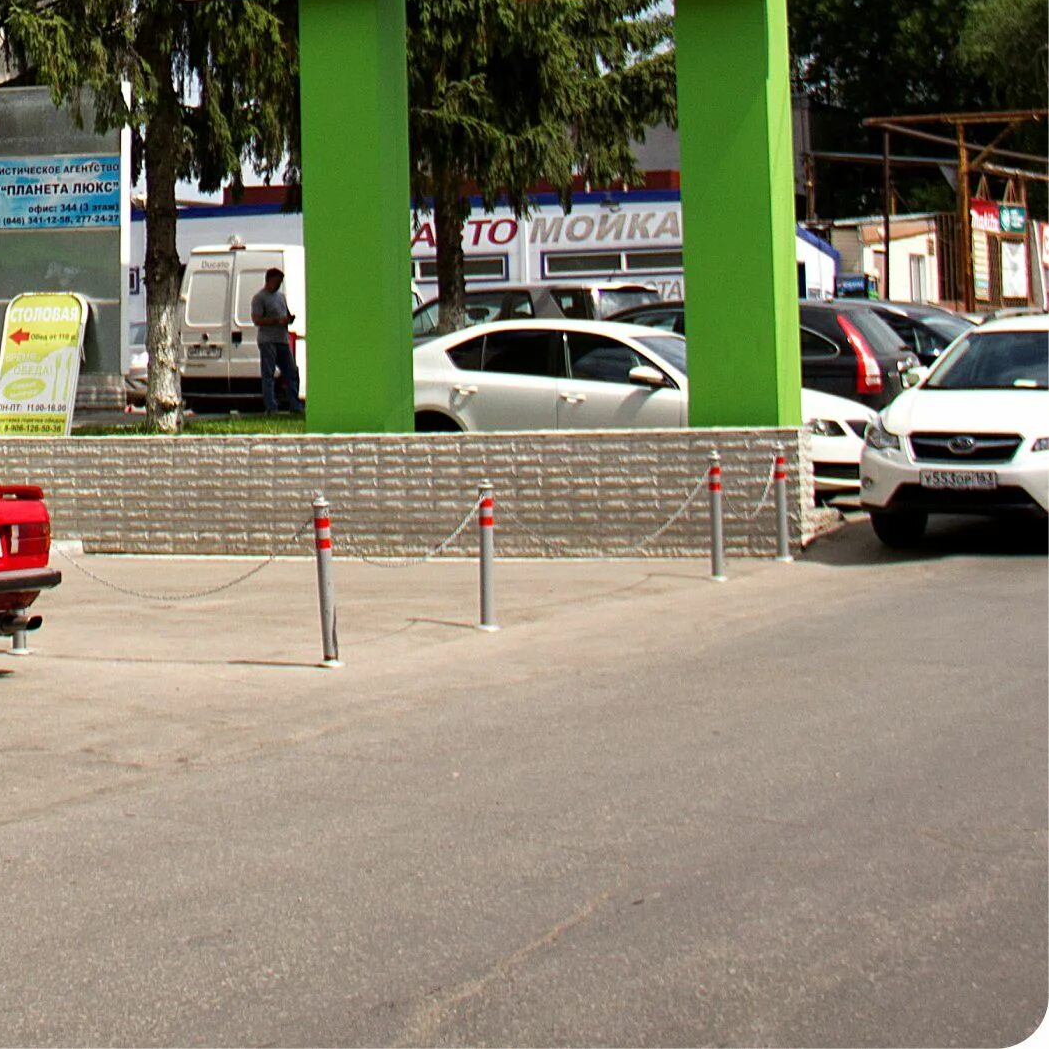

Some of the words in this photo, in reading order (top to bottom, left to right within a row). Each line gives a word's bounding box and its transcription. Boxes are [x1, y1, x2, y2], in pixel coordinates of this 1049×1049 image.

[63, 163, 120, 174] АГЕНТСТВО
[28, 205, 57, 214] офис:
[60, 203, 77, 212] 344
[79, 203, 89, 213] (3
[410, 218, 519, 249] АТО
[529, 208, 681, 244] МОЙКА
[201, 260, 229, 269] Ducato
[10, 306, 79, 323] СТОЛОВАЯ
